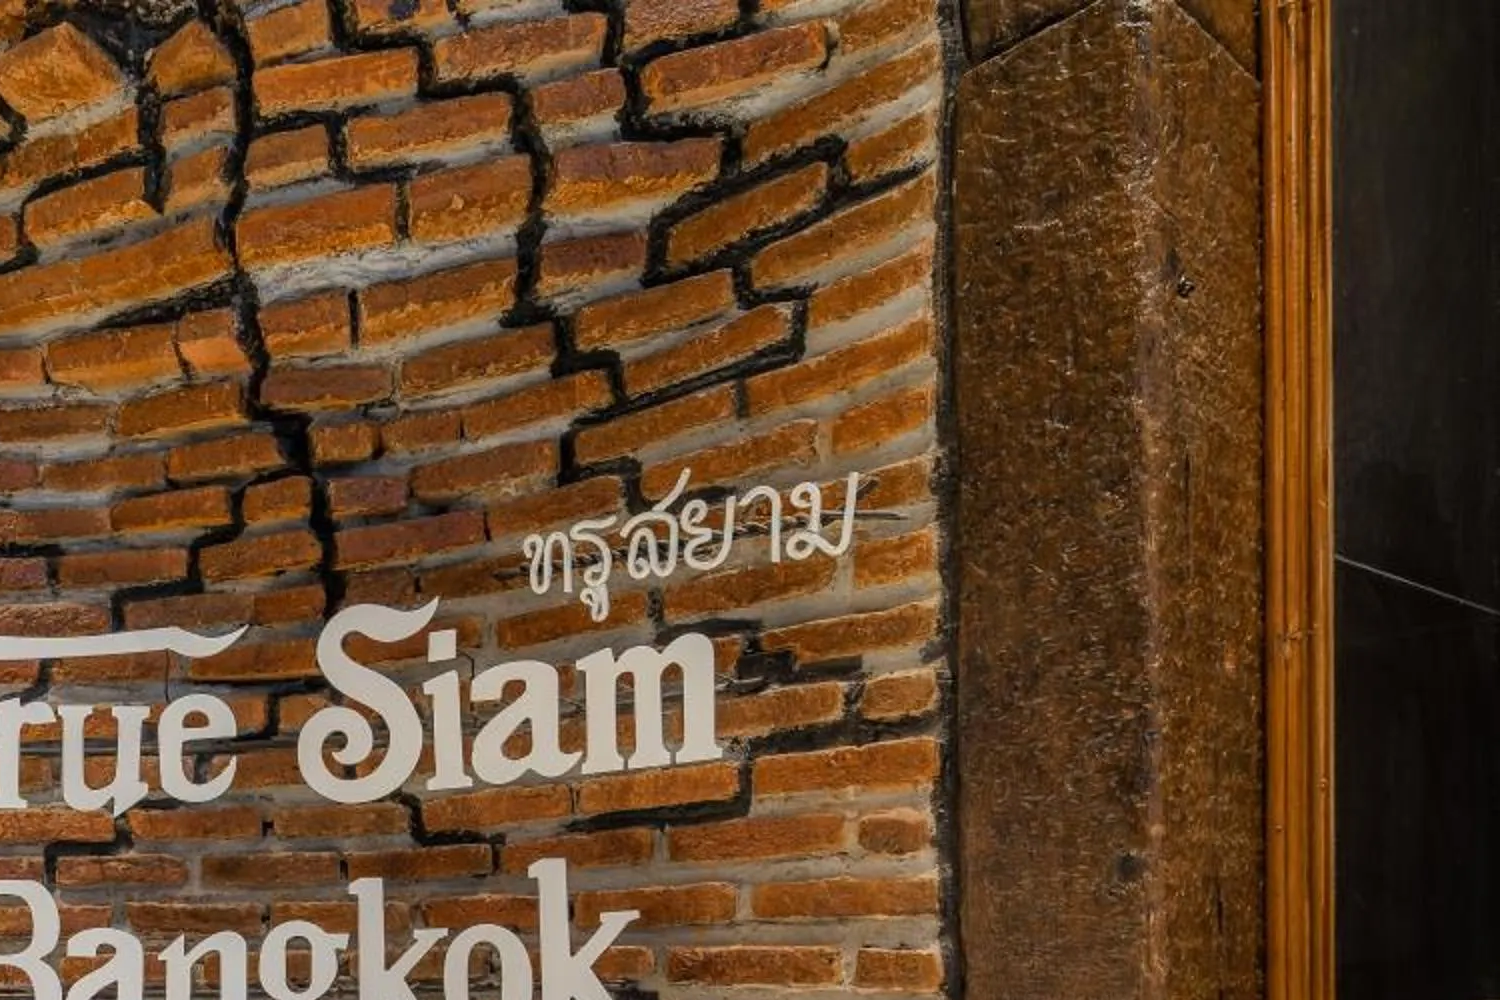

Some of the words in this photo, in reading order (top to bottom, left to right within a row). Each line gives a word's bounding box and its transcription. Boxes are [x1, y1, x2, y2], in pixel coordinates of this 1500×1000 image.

[522, 467, 860, 622] ทรูสยาม
[297, 597, 724, 804] Siam
